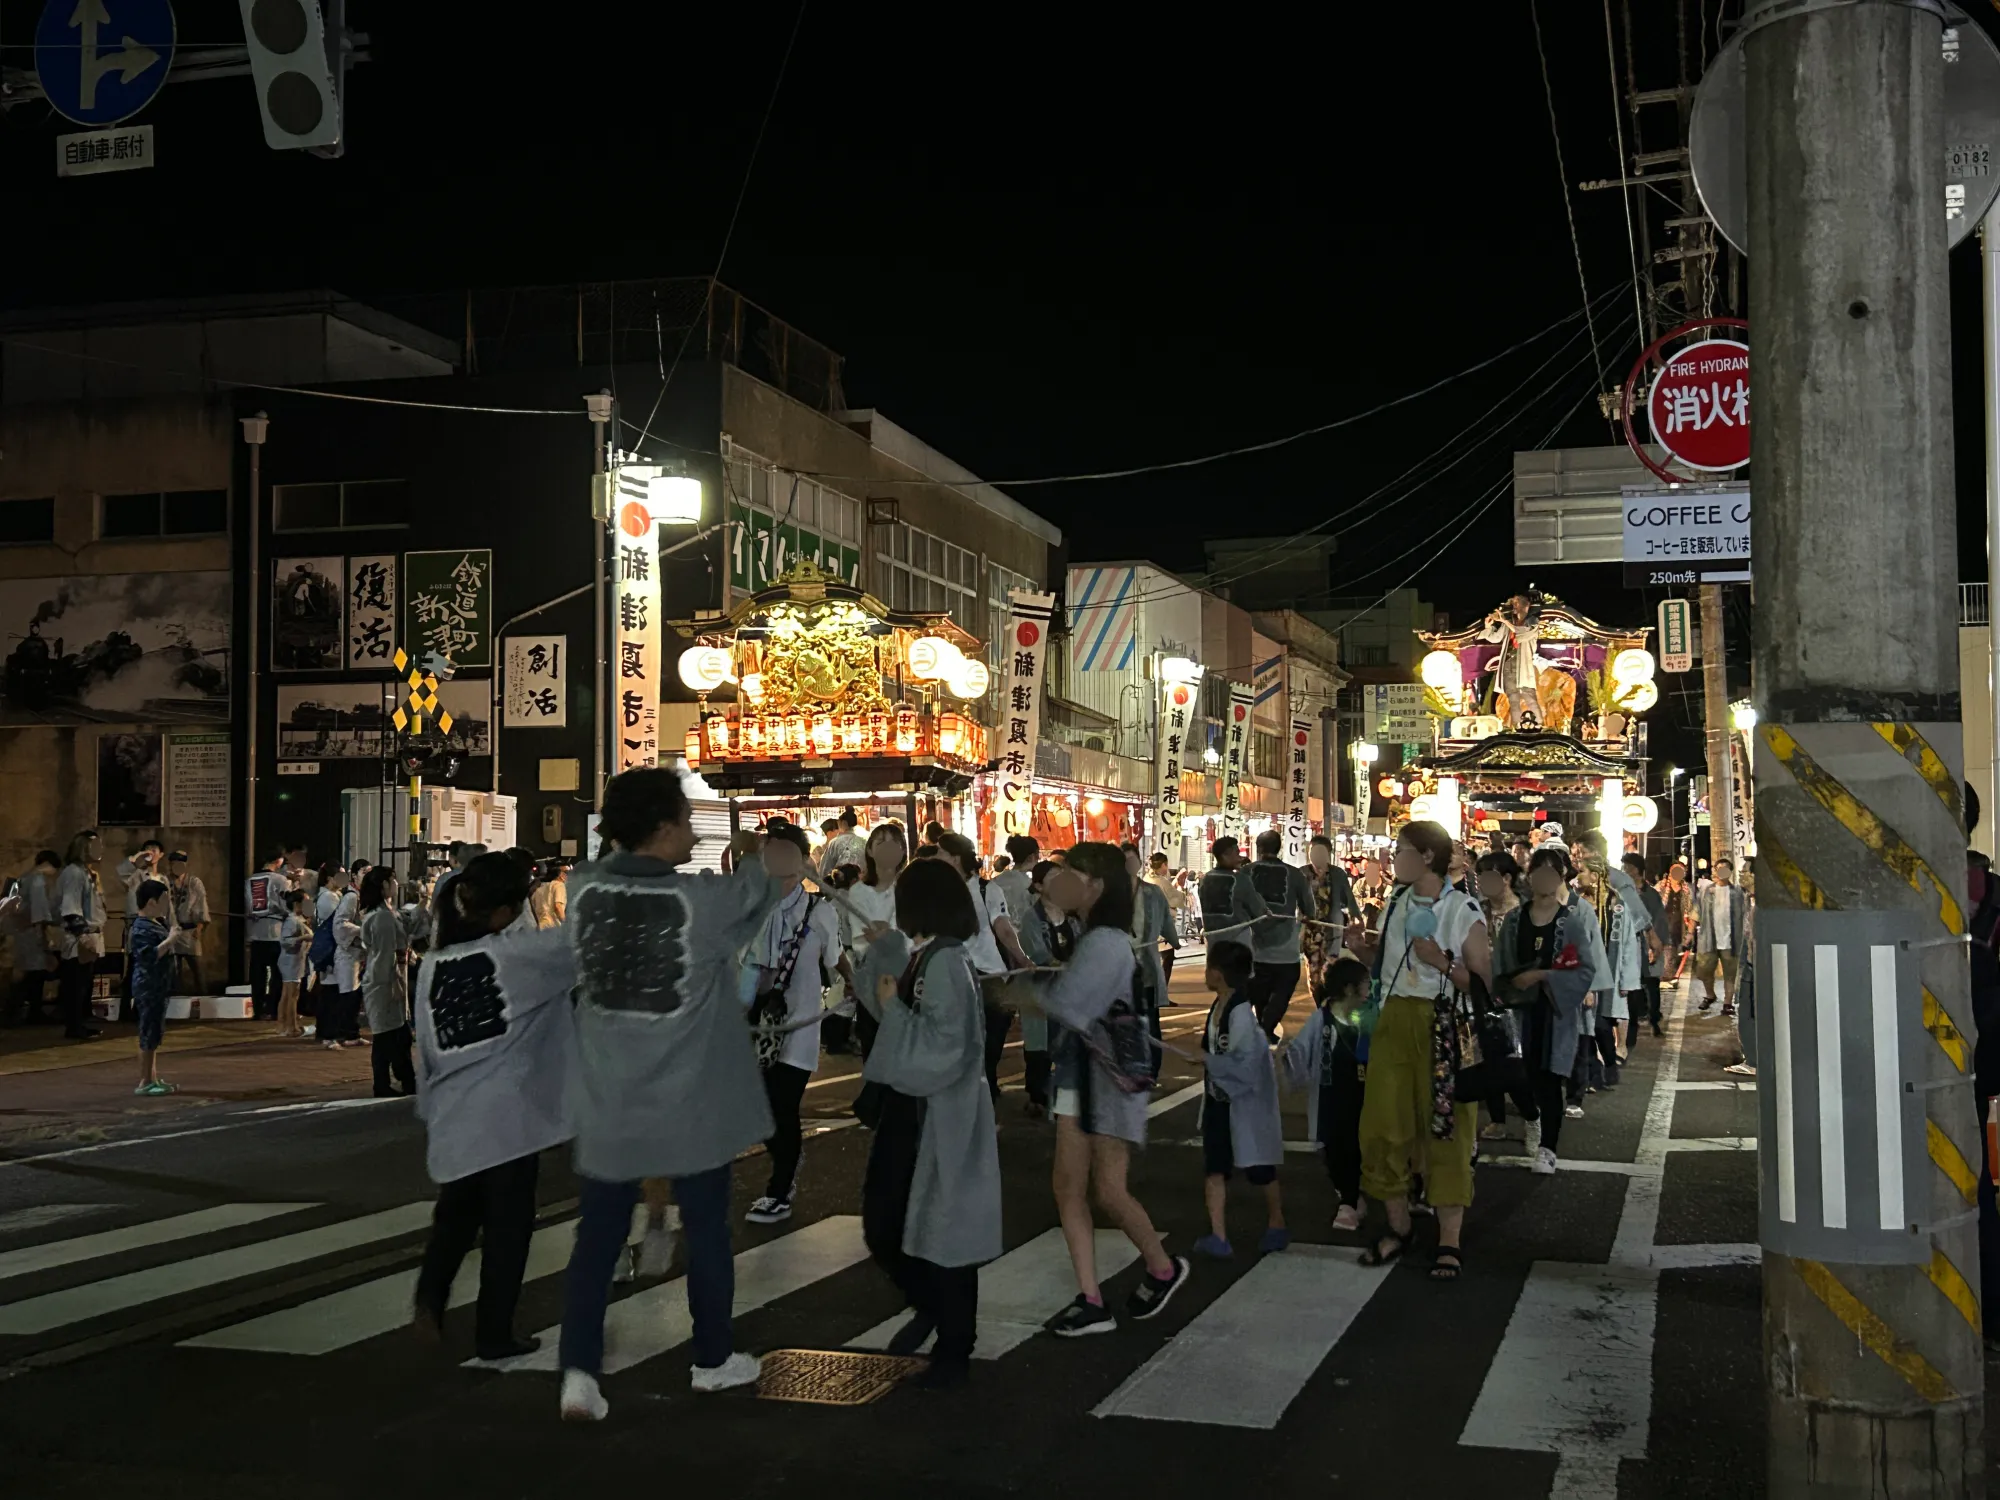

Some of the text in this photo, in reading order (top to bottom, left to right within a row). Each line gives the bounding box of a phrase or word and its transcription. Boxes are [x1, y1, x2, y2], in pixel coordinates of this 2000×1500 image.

[1953, 151, 1988, 164] 0182
[1670, 362, 1697, 377] FIRE
[1627, 505, 1722, 527] COFFEE
[1650, 569, 1696, 584] 250m先
[525, 644, 560, 717] 創活
